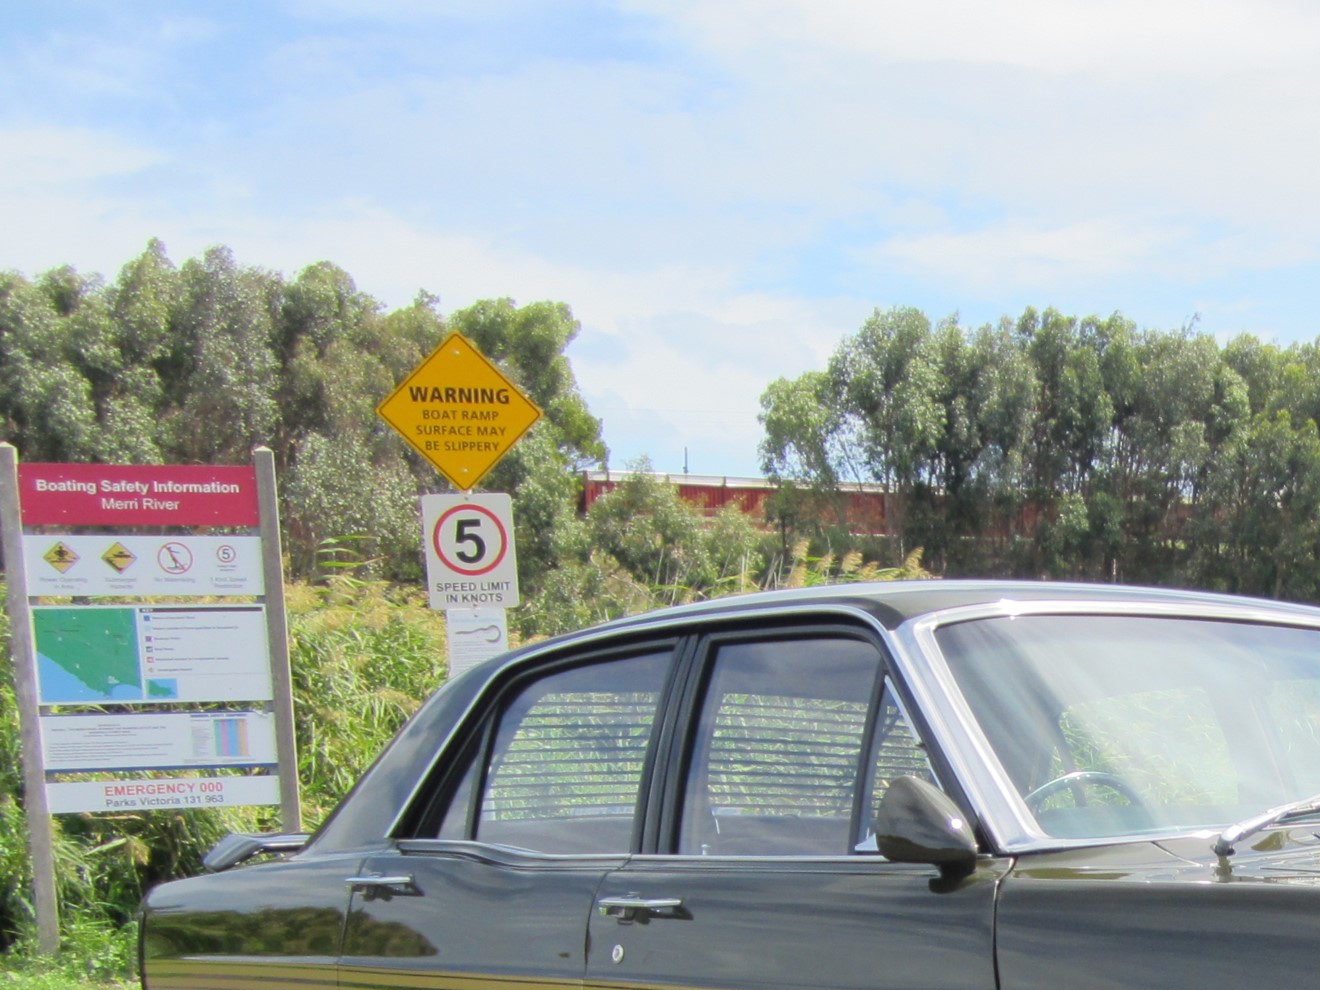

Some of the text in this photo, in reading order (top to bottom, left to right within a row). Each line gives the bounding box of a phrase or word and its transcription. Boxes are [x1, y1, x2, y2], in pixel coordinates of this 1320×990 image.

[409, 387, 510, 404] WARNING
[422, 410, 499, 421] BOAT RAMP
[416, 425, 507, 436] SURFACE MAY
[425, 441, 499, 451] BE SLIPPERY
[36, 480, 240, 494] Boating Safety Information
[102, 499, 180, 510] Merri River
[456, 519, 486, 563] 5
[437, 582, 510, 592] SPEED LIMIT
[446, 593, 503, 603] IN KNOTS
[105, 782, 223, 797] EMERGENCY 000
[106, 795, 224, 808] Parks Victoria 131 963
